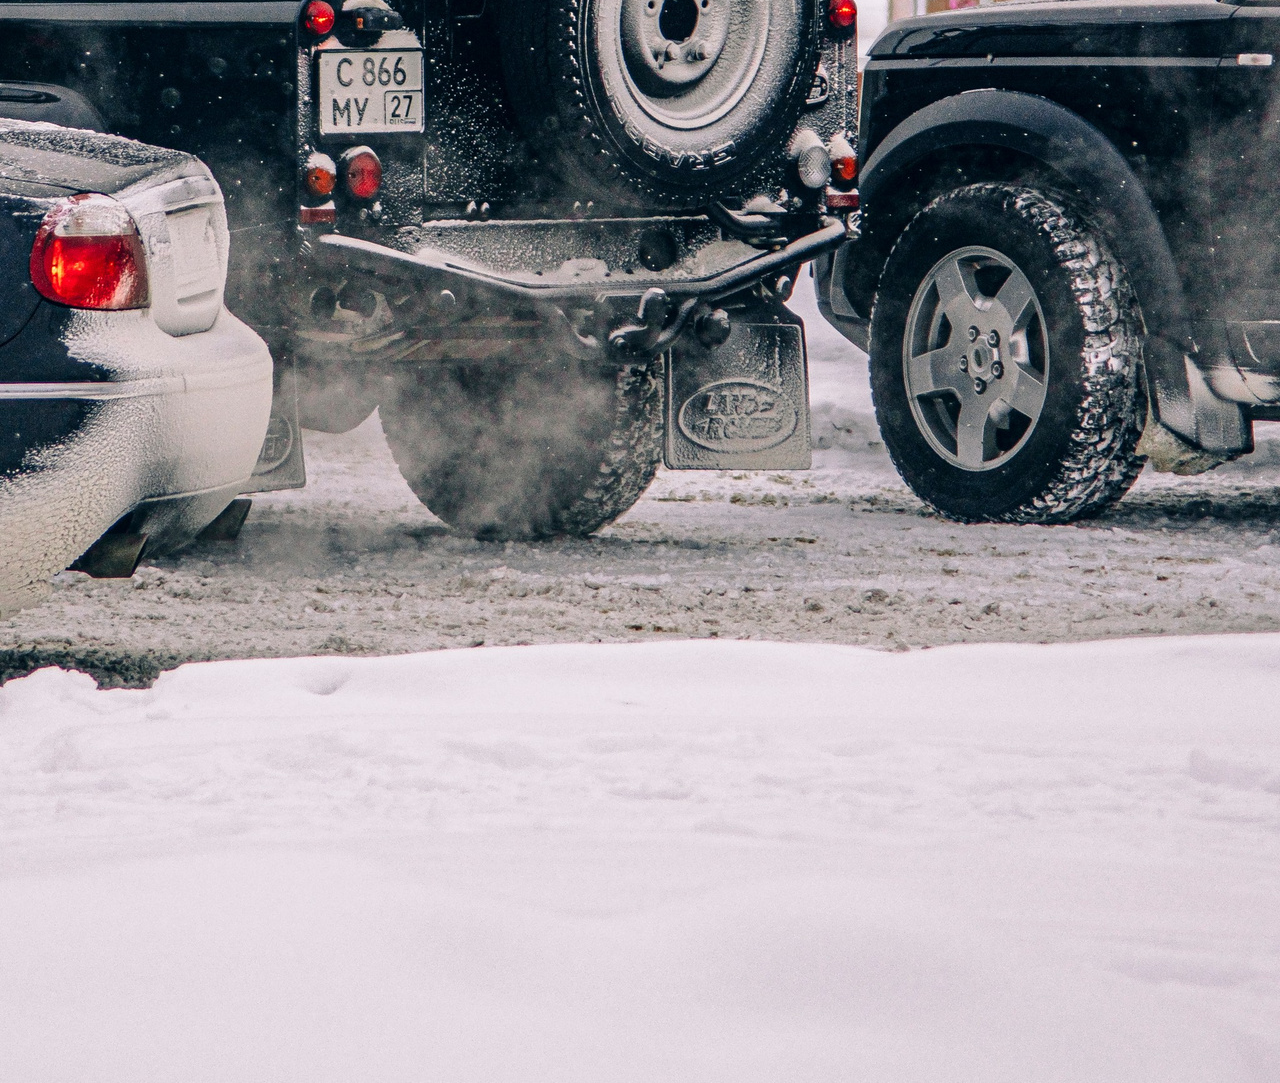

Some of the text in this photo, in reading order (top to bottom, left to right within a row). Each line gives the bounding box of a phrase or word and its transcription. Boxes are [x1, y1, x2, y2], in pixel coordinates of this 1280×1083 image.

[337, 56, 407, 87] С 866
[332, 94, 413, 127] МУ 27
